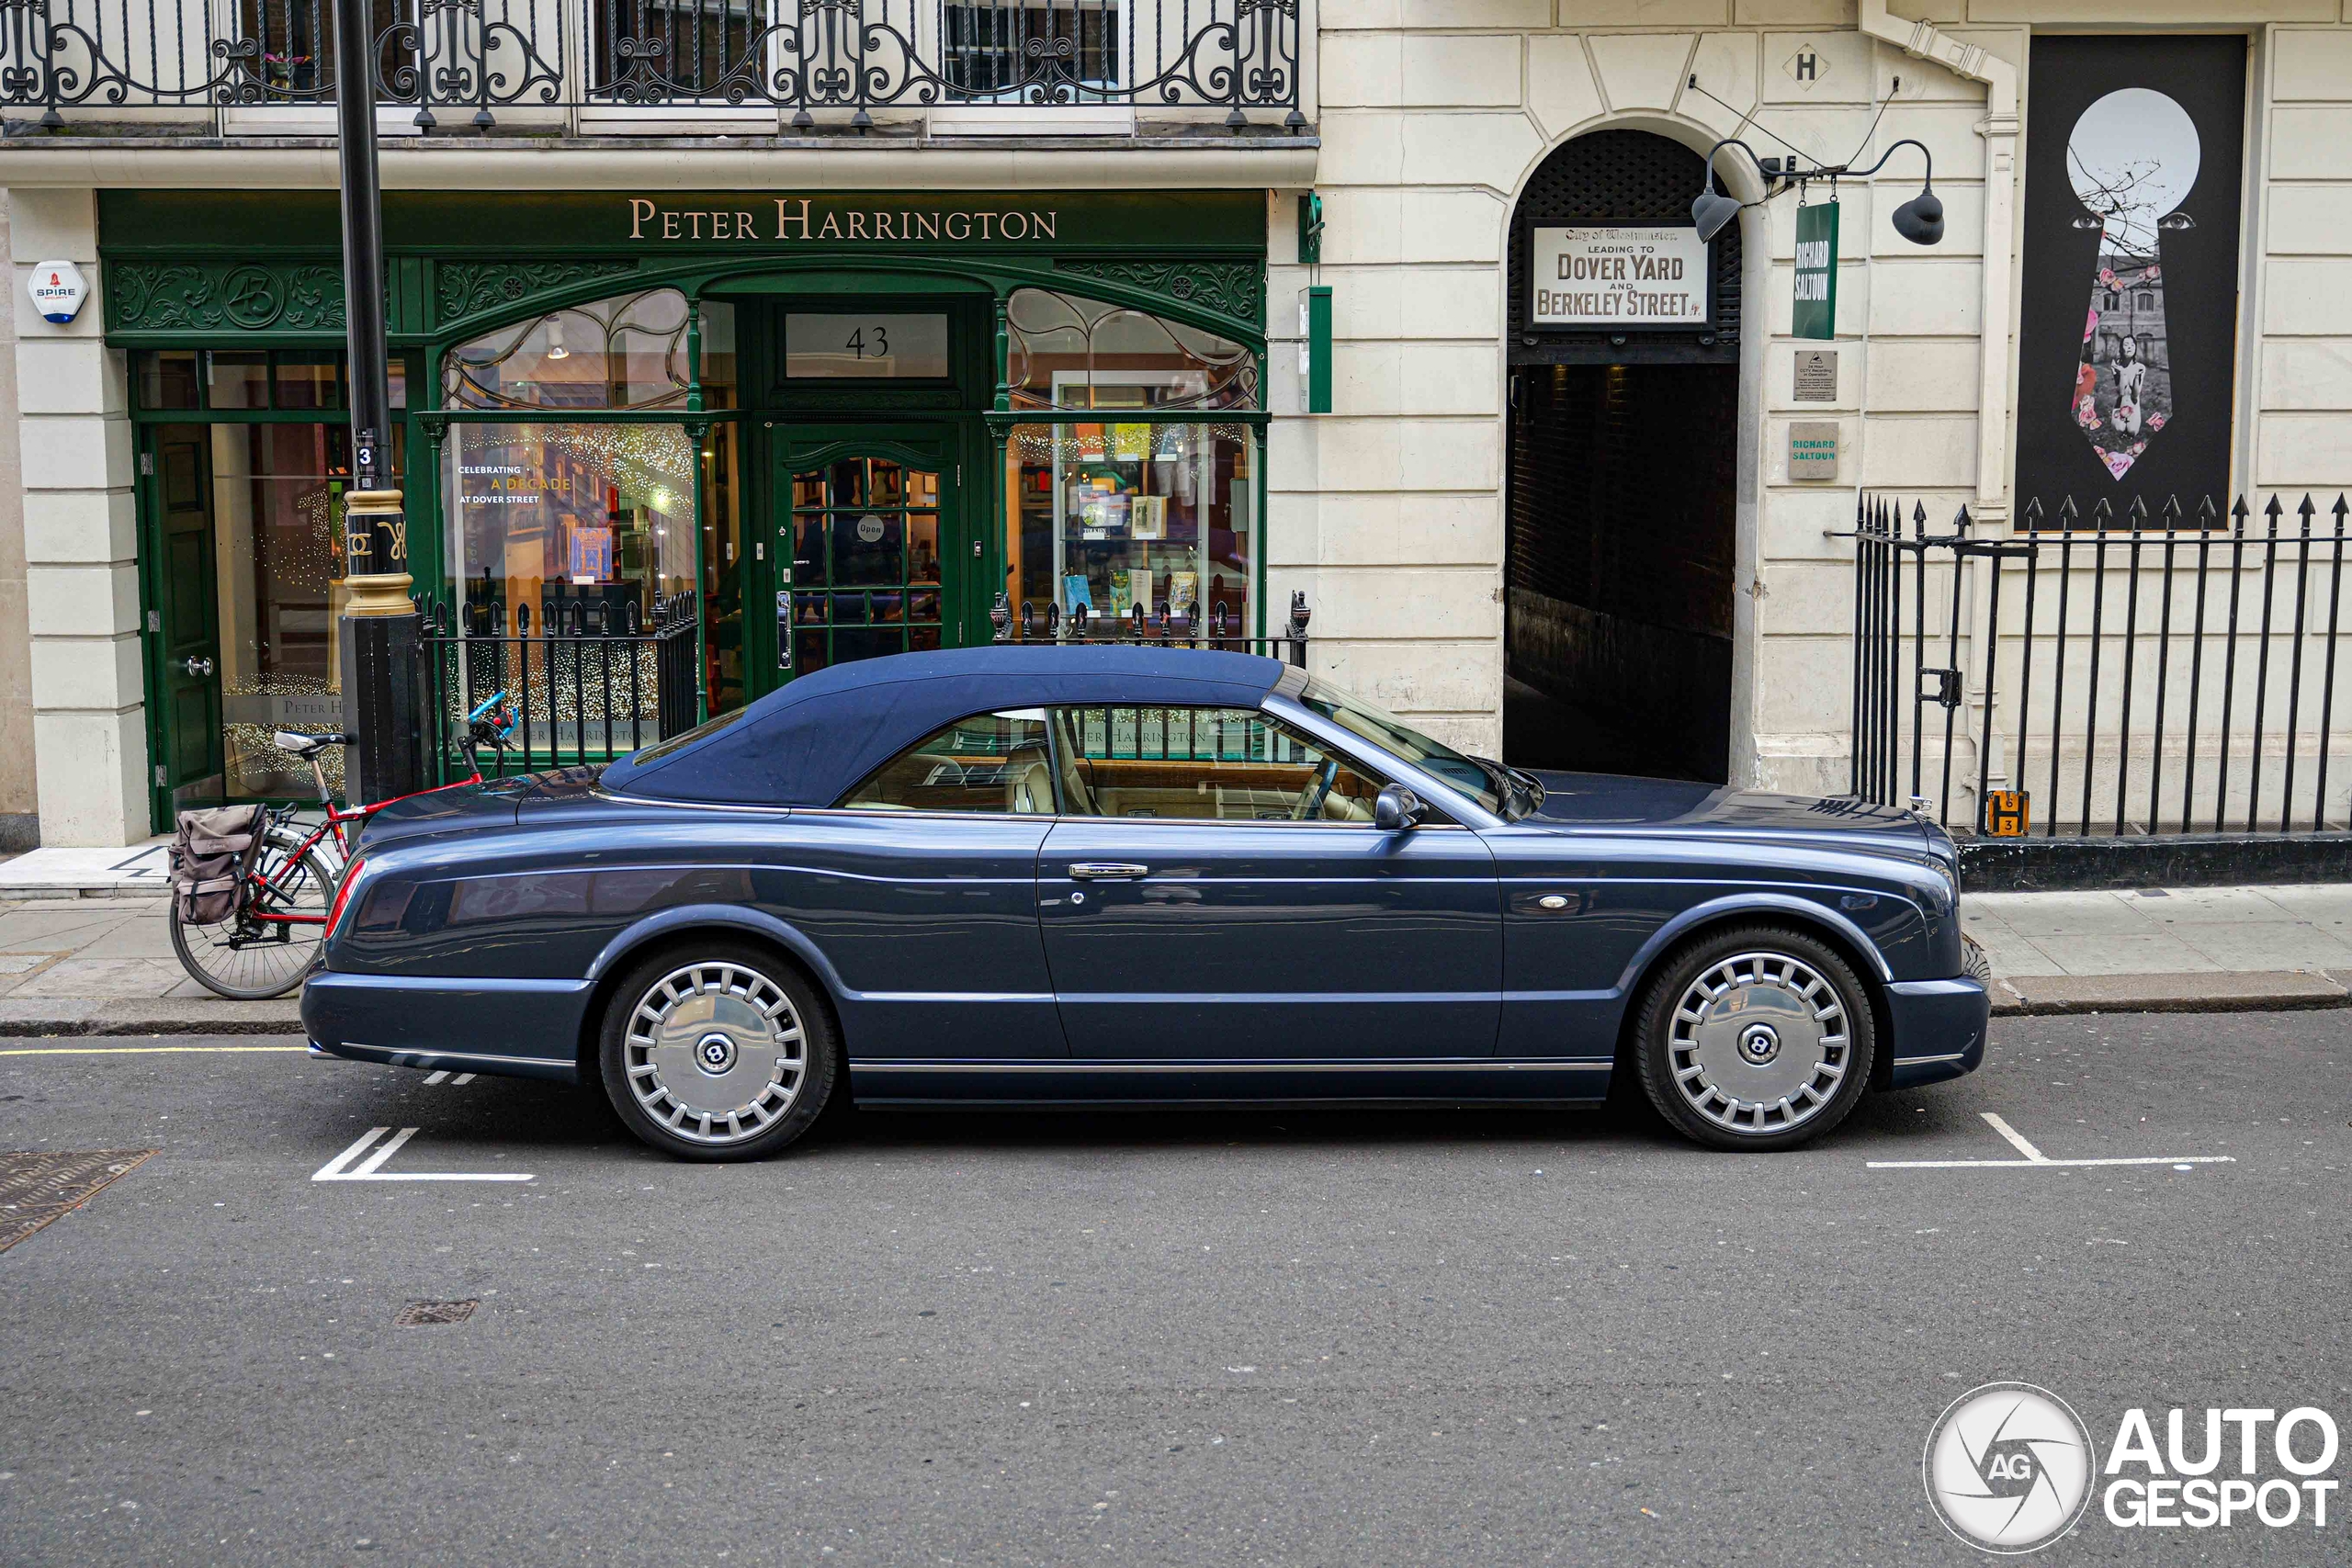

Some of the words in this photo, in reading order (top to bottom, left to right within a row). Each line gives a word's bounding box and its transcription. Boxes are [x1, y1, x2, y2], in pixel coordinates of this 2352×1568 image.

[1797, 54, 1815, 81] H
[628, 198, 759, 240] PETER
[774, 198, 1057, 240] HARRINGTON
[1566, 229, 1589, 242] City
[1592, 229, 1603, 240] of
[1588, 245, 1634, 254] LEADING
[1640, 245, 1655, 254] TO
[1795, 240, 1829, 269] RICHARD
[1557, 254, 1626, 280] DOVER
[1630, 254, 1683, 280] YARD
[37, 288, 75, 297] SPIRE
[1794, 273, 1828, 301] SALTOUN
[1538, 288, 1623, 316] BERKELEY
[1626, 289, 1689, 316] STREET
[846, 326, 888, 359] 43
[1792, 440, 1835, 449] RICHARD
[359, 448, 371, 465] 3
[1792, 452, 1835, 460] SALTOUN
[458, 466, 521, 474] CELEBRATING
[491, 478, 502, 491] A
[506, 478, 571, 491] DECADE
[860, 524, 881, 534] Open
[284, 700, 325, 714] PETER
[2005, 820, 2013, 830] 3
